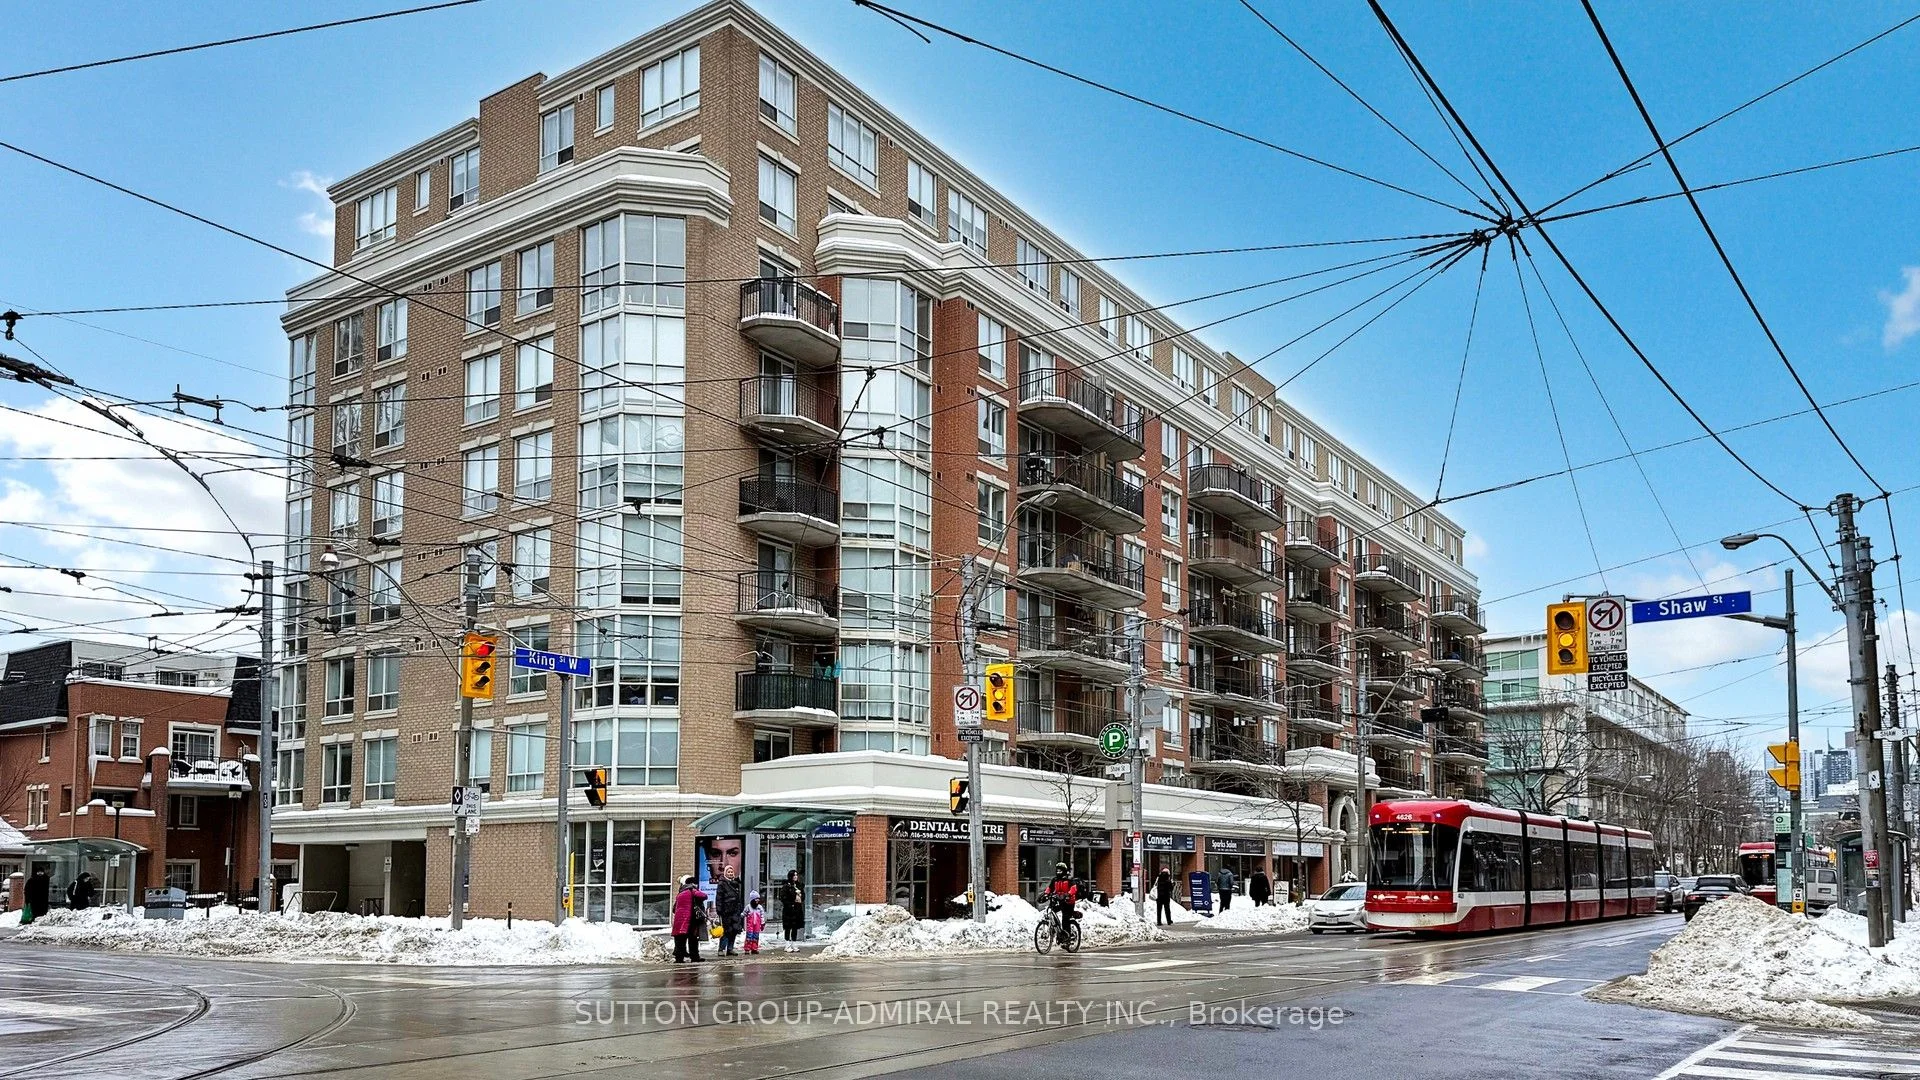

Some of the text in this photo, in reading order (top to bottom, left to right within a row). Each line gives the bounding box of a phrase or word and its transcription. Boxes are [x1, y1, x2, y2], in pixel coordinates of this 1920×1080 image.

[1659, 595, 1723, 616] Shaw St
[529, 651, 555, 670] King
[568, 657, 578, 670] W
[1600, 654, 1627, 662] VEHICLES
[1591, 681, 1625, 689] EXCEPTED
[1592, 674, 1623, 682] BICYCLES
[1109, 732, 1121, 746] P
[910, 820, 1004, 834] DENTAL CTRE
